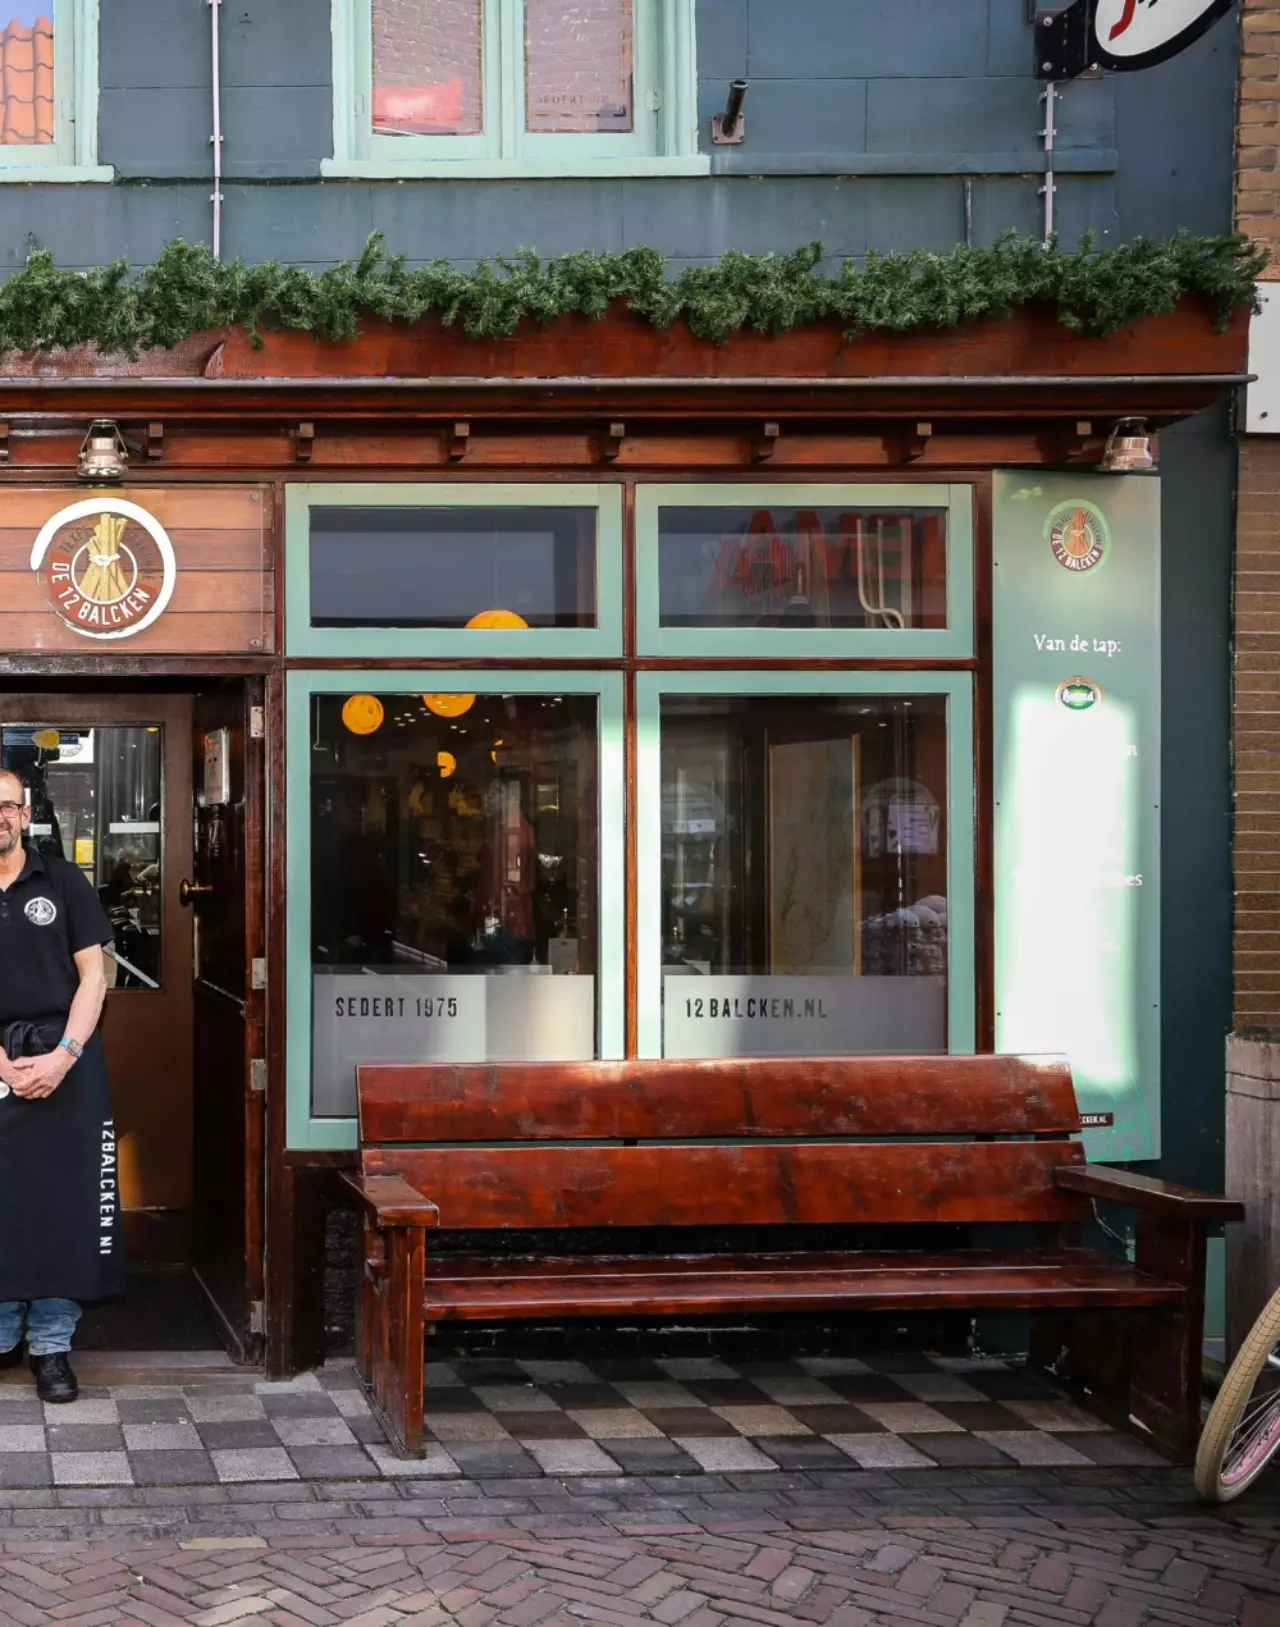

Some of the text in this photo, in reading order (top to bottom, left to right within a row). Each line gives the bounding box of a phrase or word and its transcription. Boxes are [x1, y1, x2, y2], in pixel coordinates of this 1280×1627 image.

[52, 562, 150, 625] DE 12 BALCKEN
[1033, 635, 1122, 657] Van de tap:
[335, 997, 457, 1017] SEDERT 1975
[686, 998, 827, 1018] 12BALCKEN.NL
